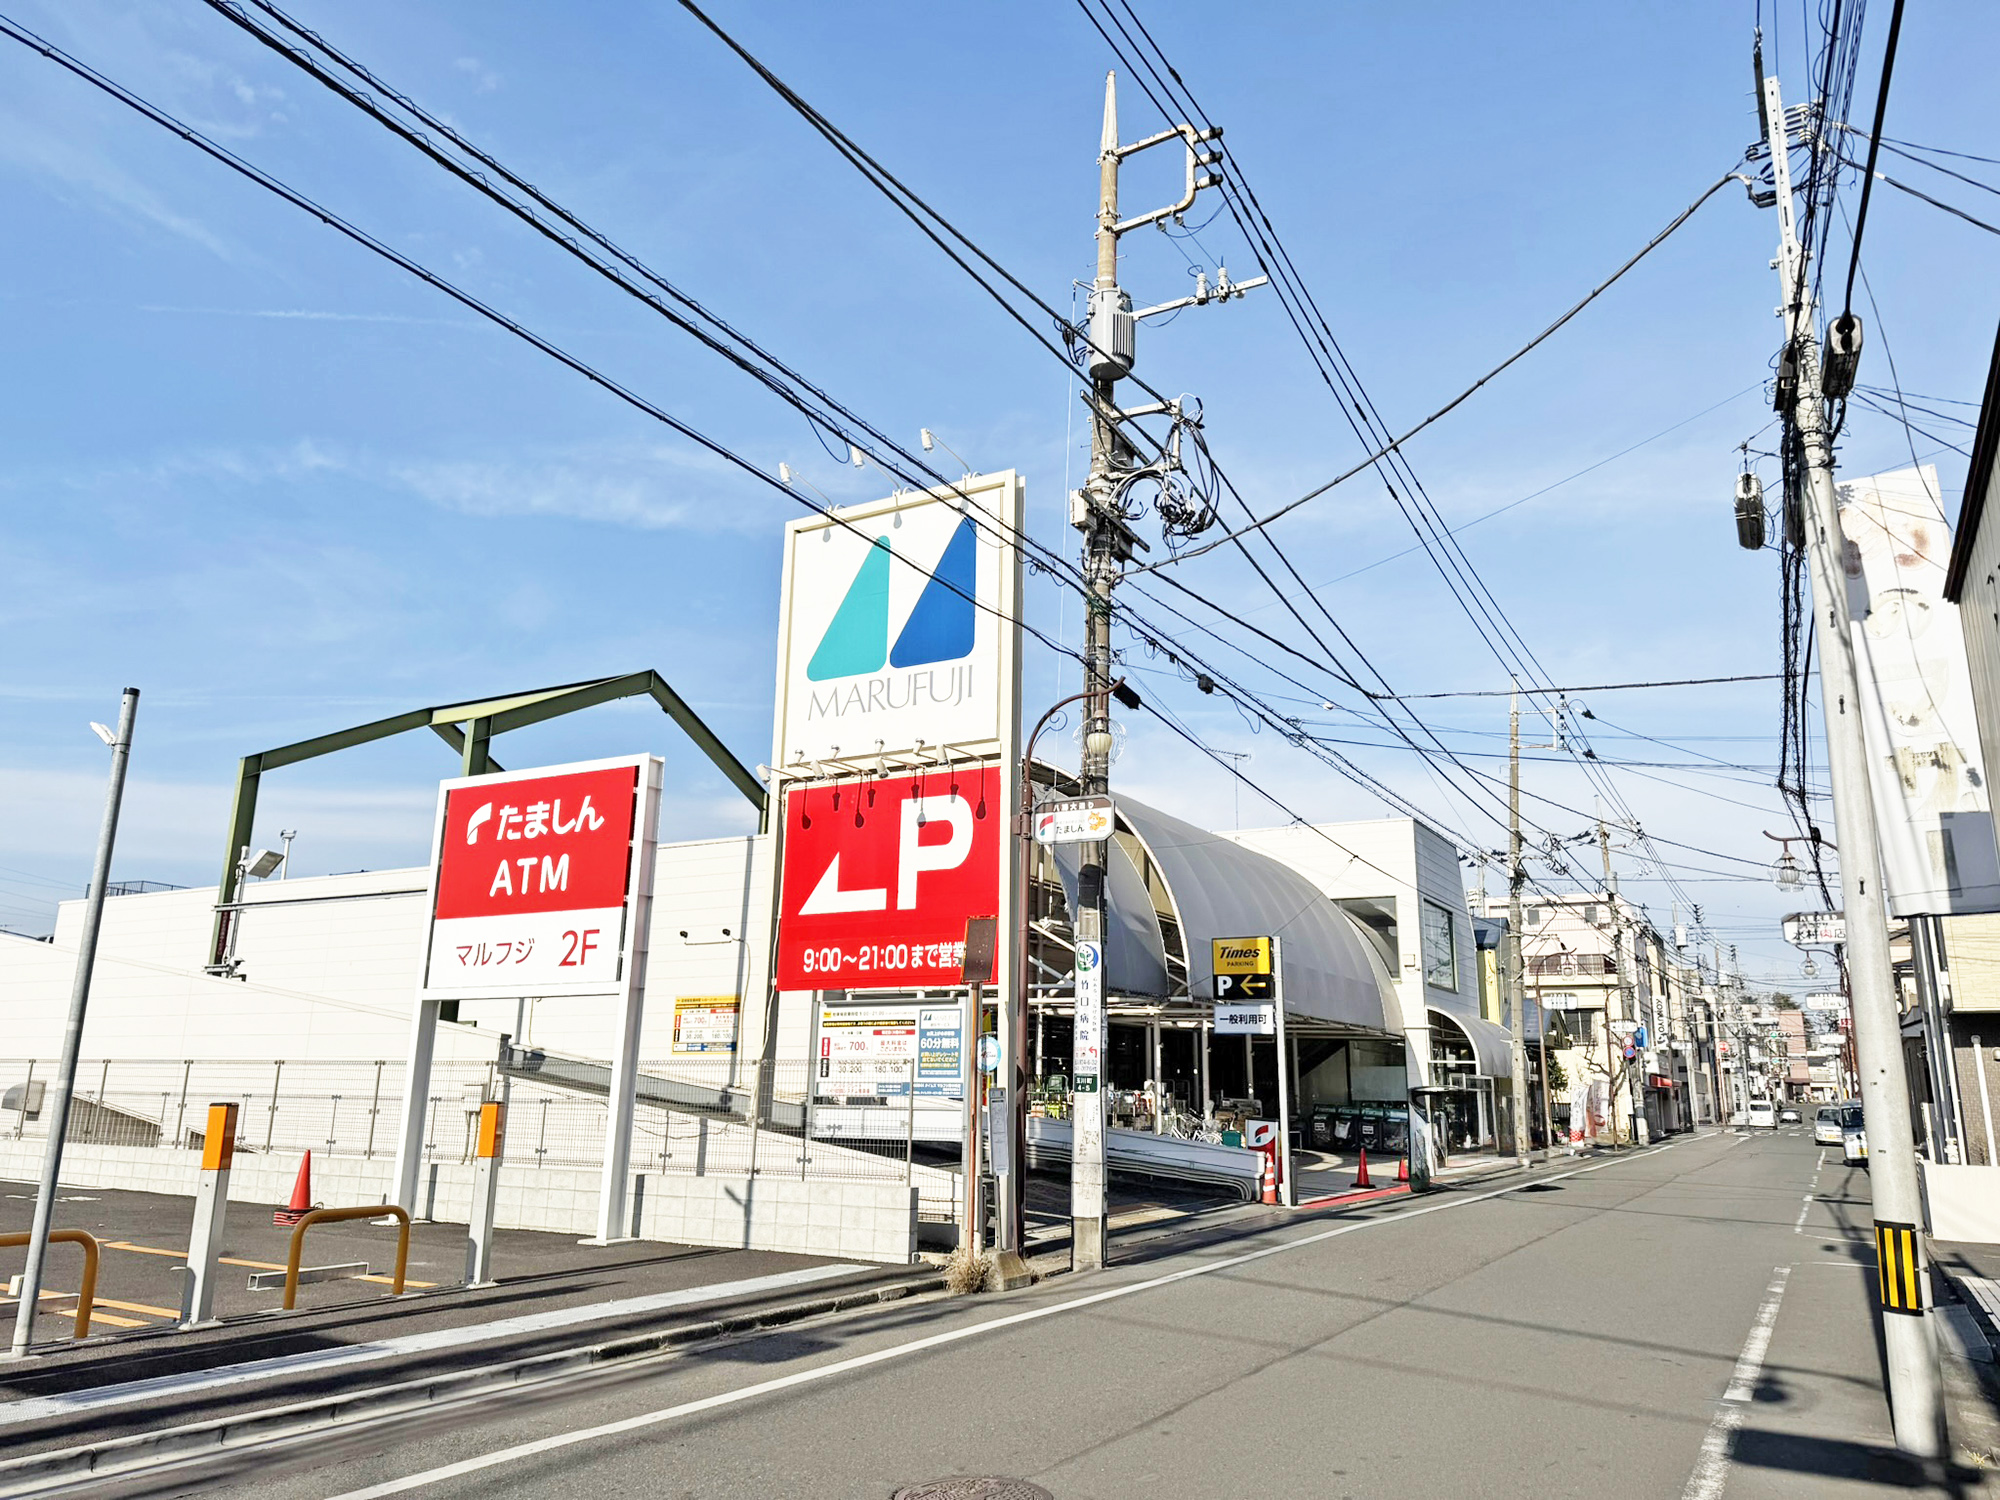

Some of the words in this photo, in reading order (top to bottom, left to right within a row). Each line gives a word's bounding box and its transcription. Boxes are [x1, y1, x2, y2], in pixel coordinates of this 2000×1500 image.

[808, 665, 973, 721] MARUFUJI
[496, 795, 605, 841] たましん
[1056, 824, 1086, 835] たましん
[897, 794, 974, 910] P
[489, 853, 570, 898] ATM
[456, 938, 536, 967] マルフジ
[558, 929, 601, 967] 2F
[1219, 946, 1261, 959] Times
[1217, 976, 1233, 997] P
[1080, 979, 1089, 1041] 竹口病院
[1219, 1014, 1267, 1025] 一般利用可
[920, 1037, 960, 1049] 60分無料
